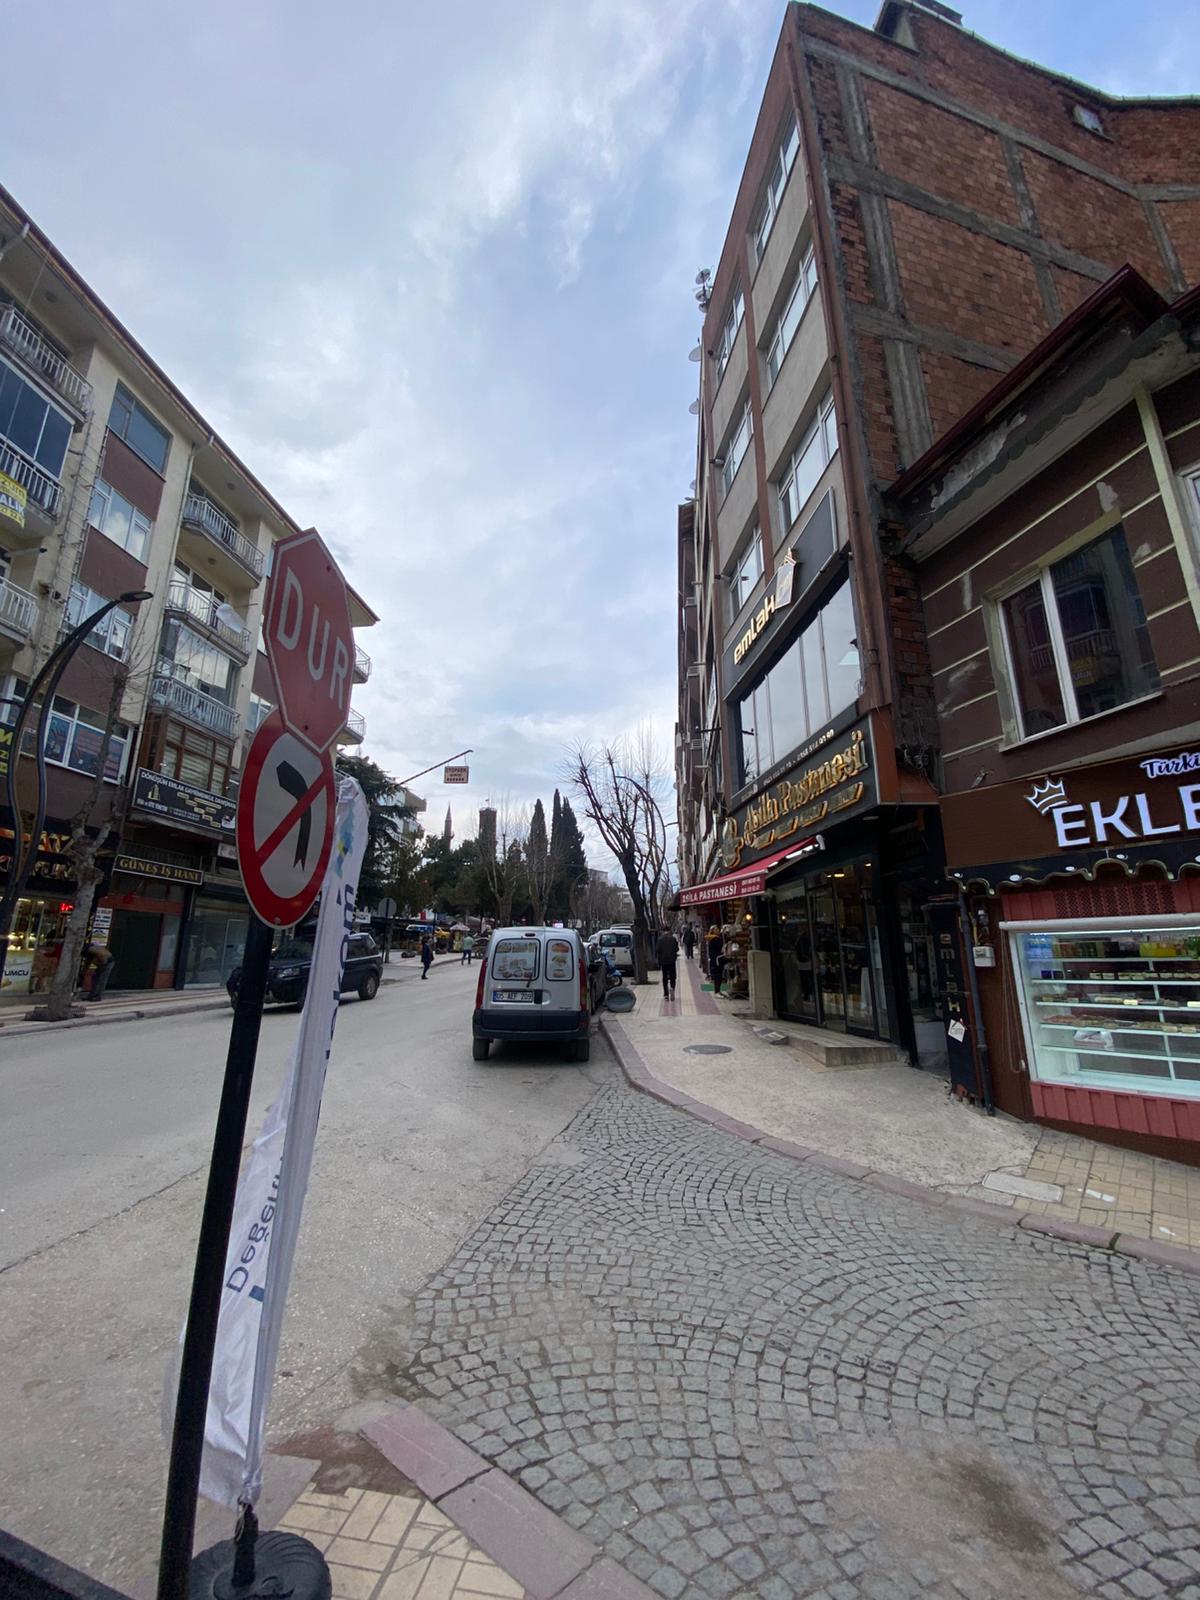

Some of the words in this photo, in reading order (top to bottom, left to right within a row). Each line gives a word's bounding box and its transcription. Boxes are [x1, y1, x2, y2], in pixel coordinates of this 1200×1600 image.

[276, 567, 349, 711] DUR
[120, 859, 158, 875] GÜNEŞ
[699, 881, 737, 900] PASTANESİ
